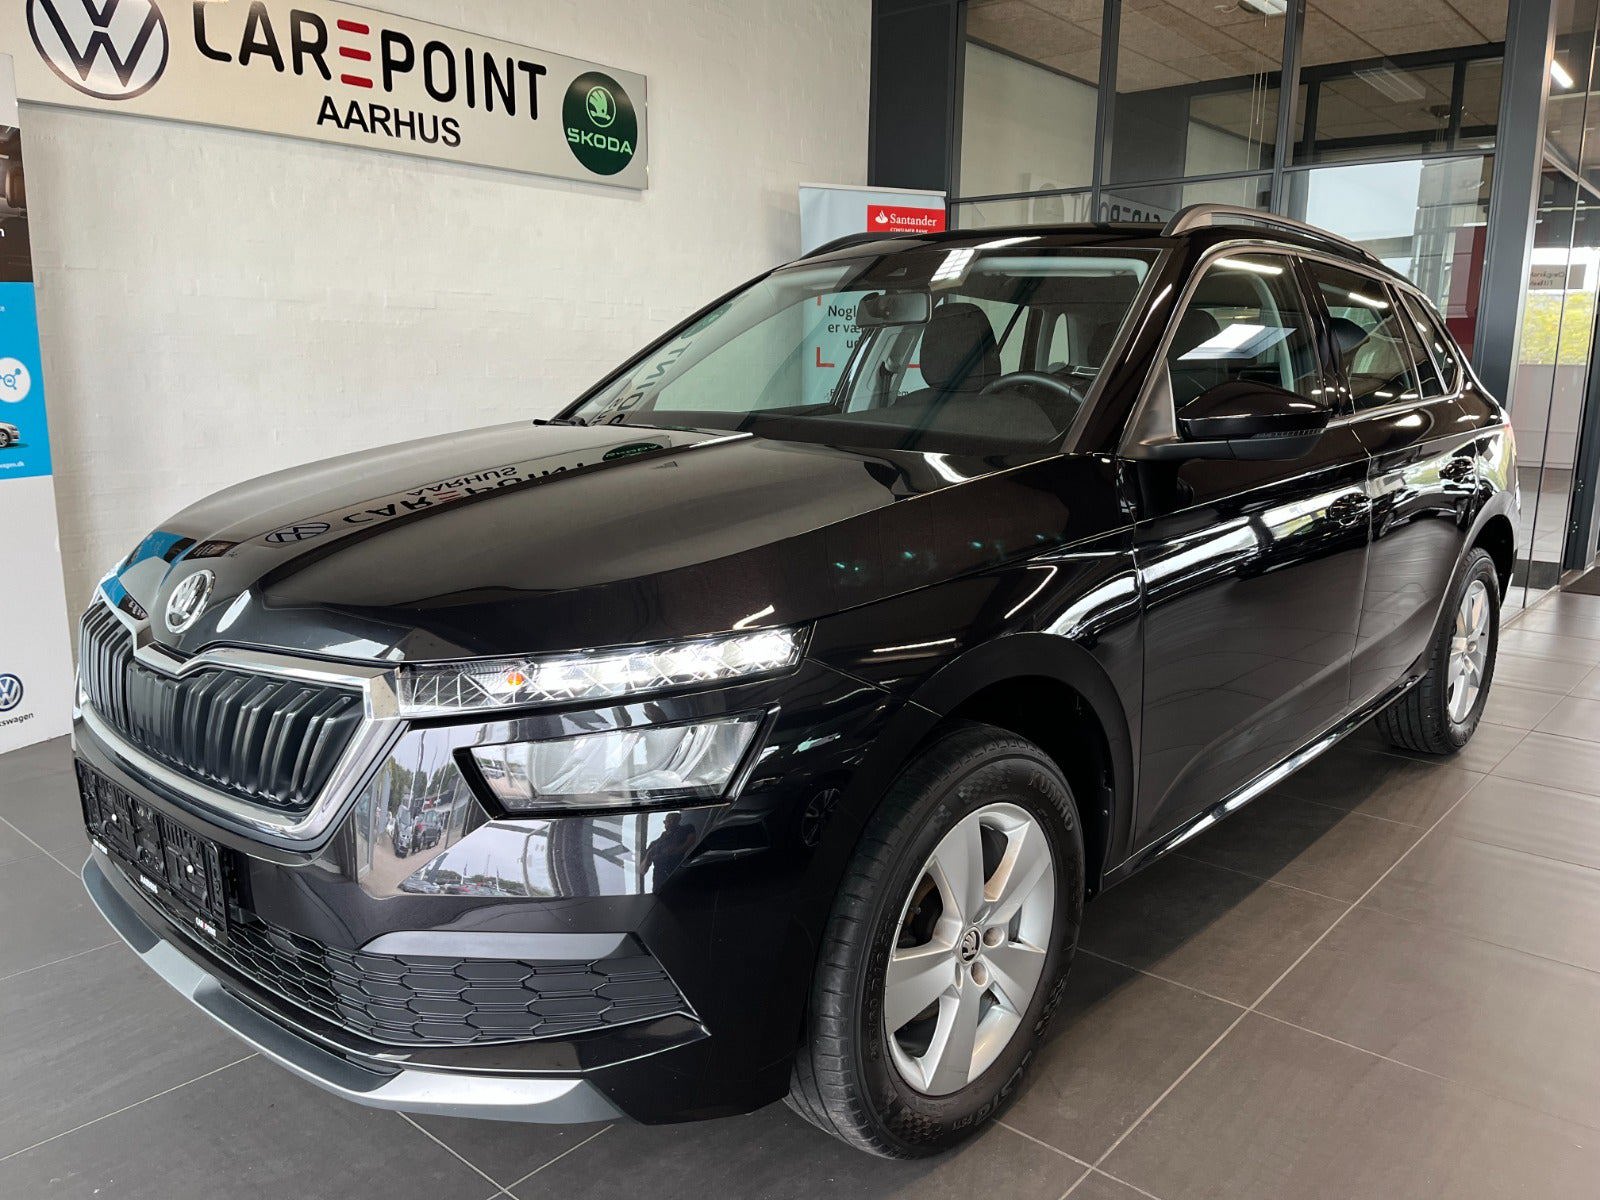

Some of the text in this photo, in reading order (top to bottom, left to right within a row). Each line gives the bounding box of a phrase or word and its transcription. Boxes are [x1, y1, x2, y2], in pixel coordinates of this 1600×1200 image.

[317, 95, 461, 147] AARHUS
[890, 213, 937, 227] Santander
[828, 305, 857, 321] Nogl
[828, 324, 862, 333] er væ
[0, 712, 34, 727] swagen
